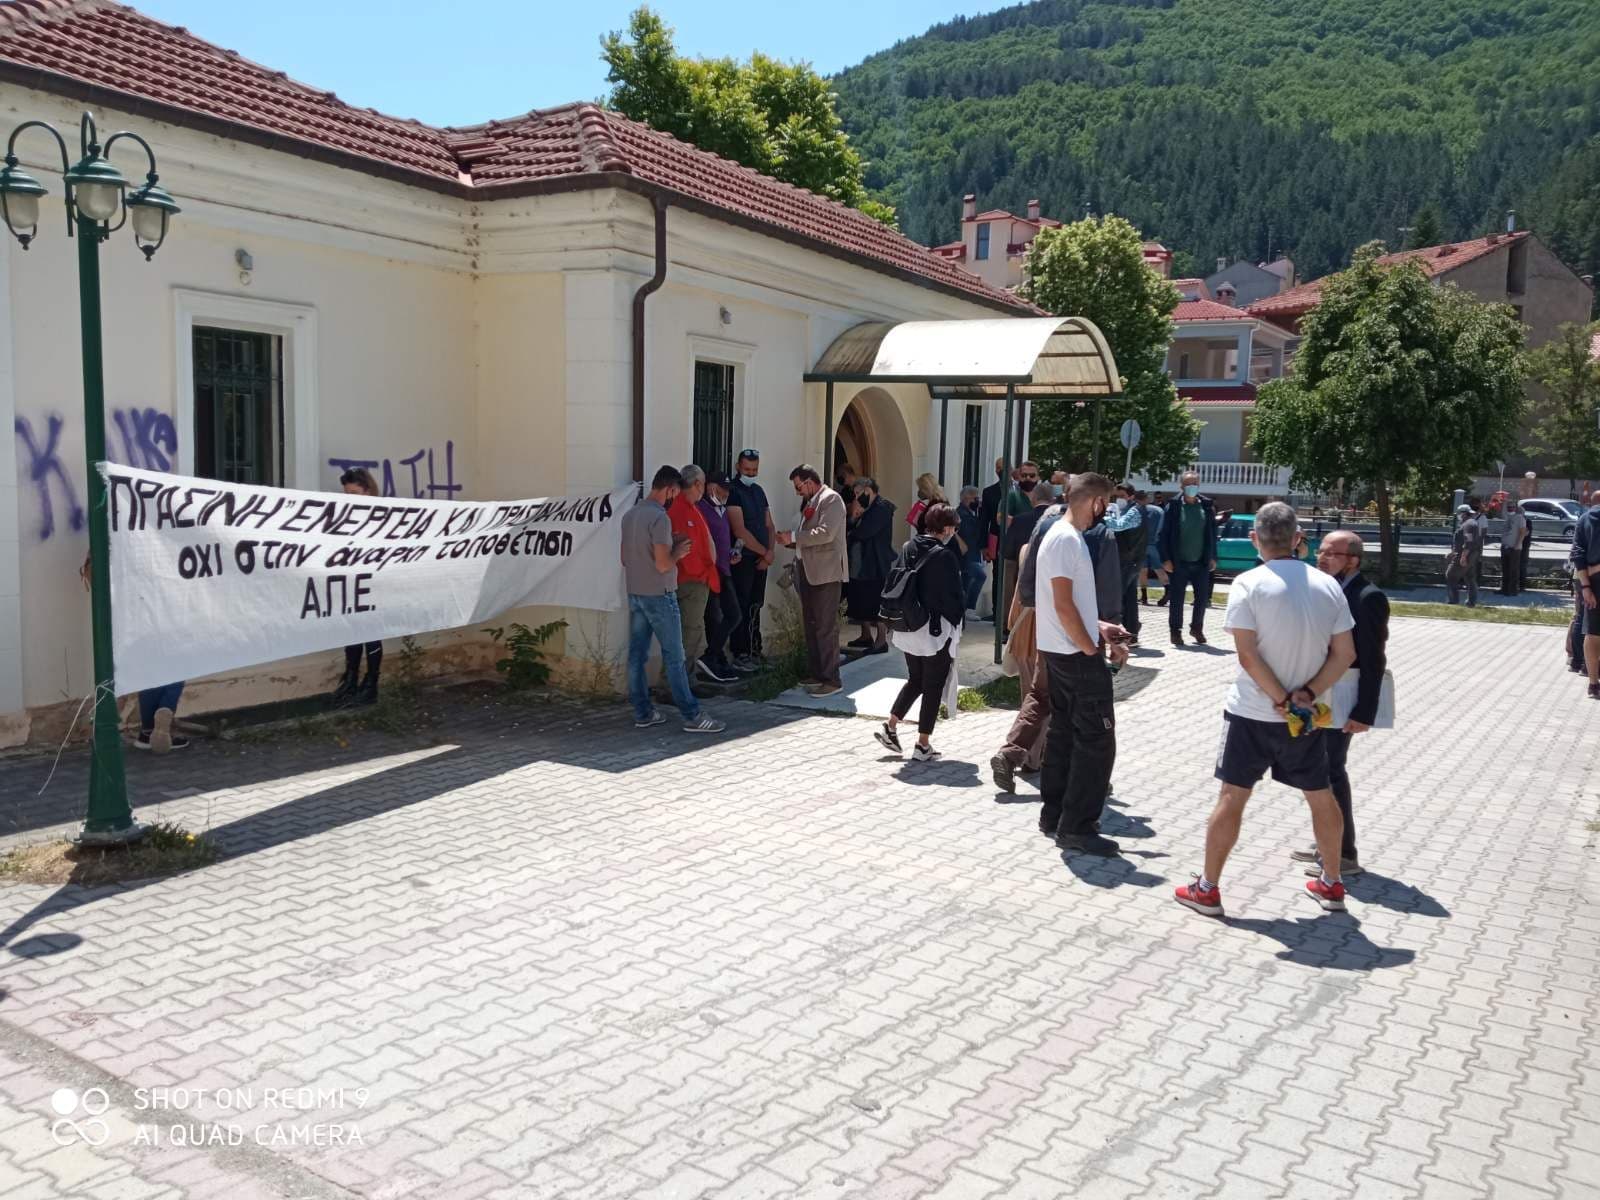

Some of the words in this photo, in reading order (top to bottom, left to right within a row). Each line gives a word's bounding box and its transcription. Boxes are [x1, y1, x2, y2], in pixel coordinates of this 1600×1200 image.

[434, 507, 486, 538] ΚΑΙ
[235, 540, 321, 575] στην
[325, 541, 430, 571] άναρχη
[435, 526, 573, 560] τοποθέτηση
[300, 573, 376, 619] Α.Π.Ε.
